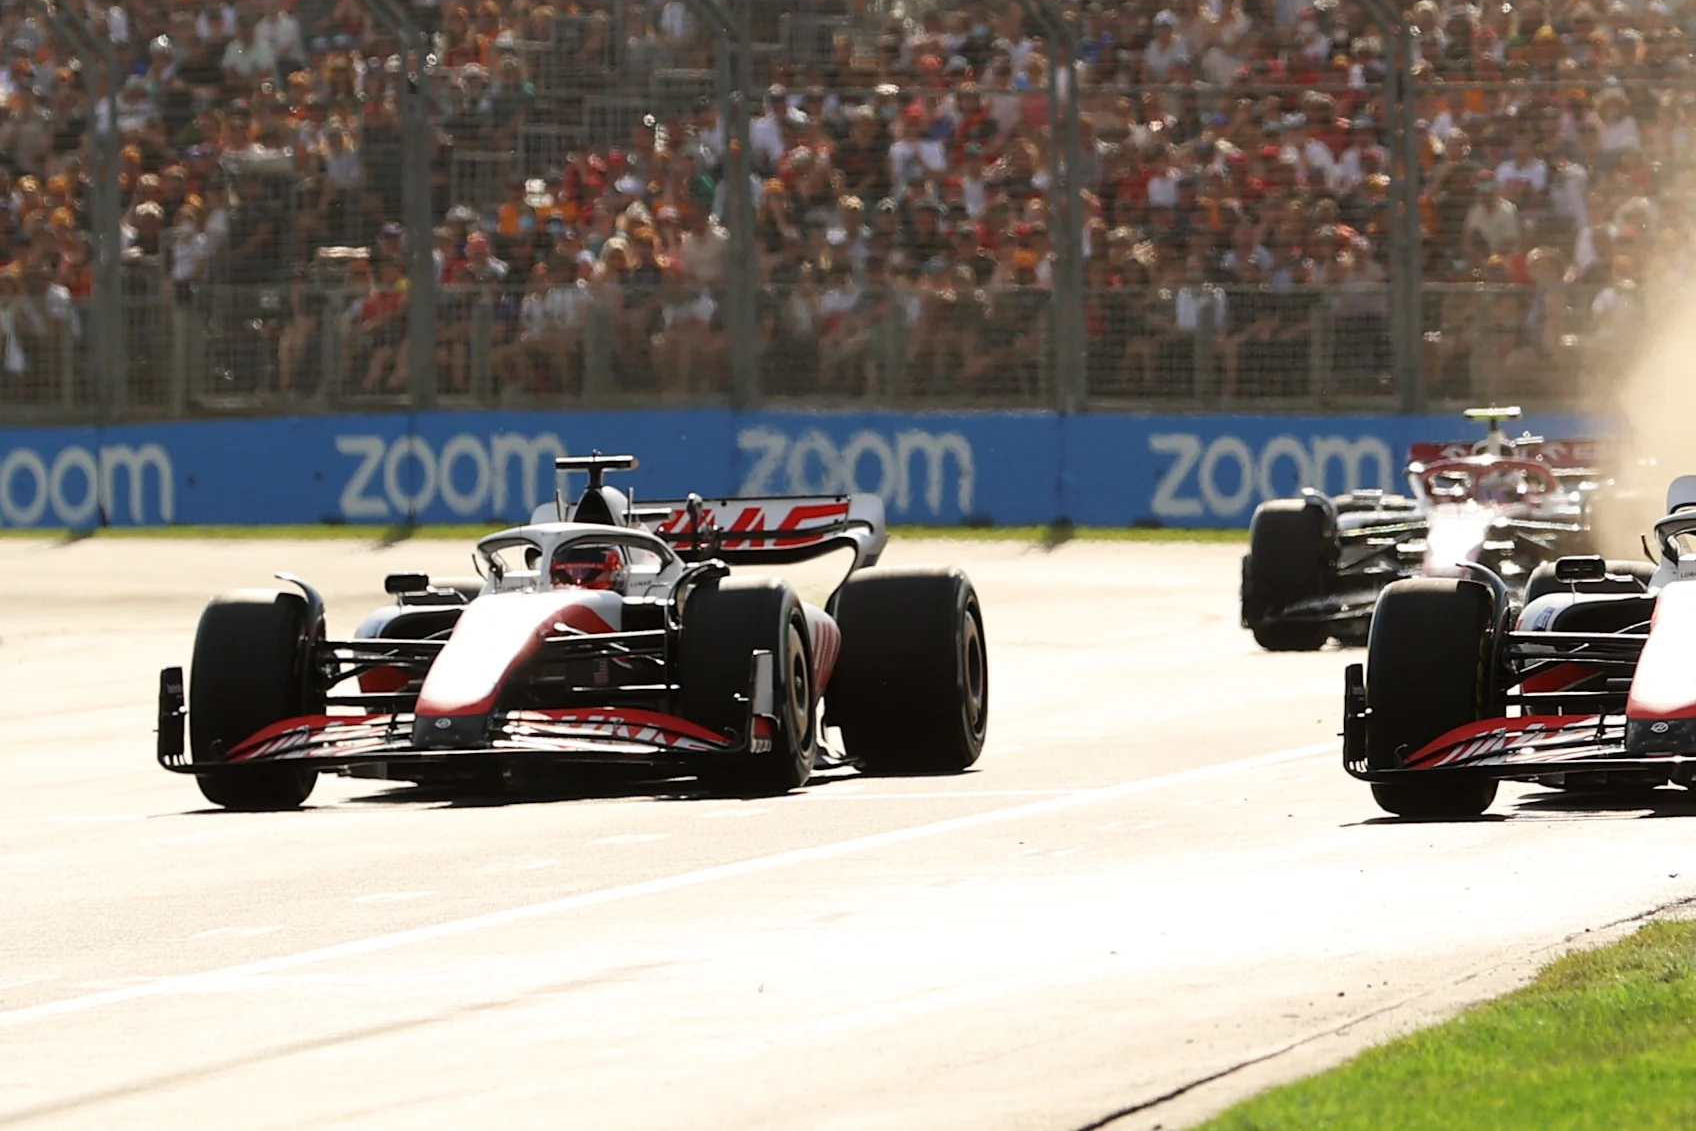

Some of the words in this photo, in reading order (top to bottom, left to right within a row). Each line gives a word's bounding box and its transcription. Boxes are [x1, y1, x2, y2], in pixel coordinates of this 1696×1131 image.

[0, 444, 176, 525] oom
[334, 433, 574, 517] zoom
[736, 426, 973, 515] zoom
[1149, 433, 1392, 516] zoom
